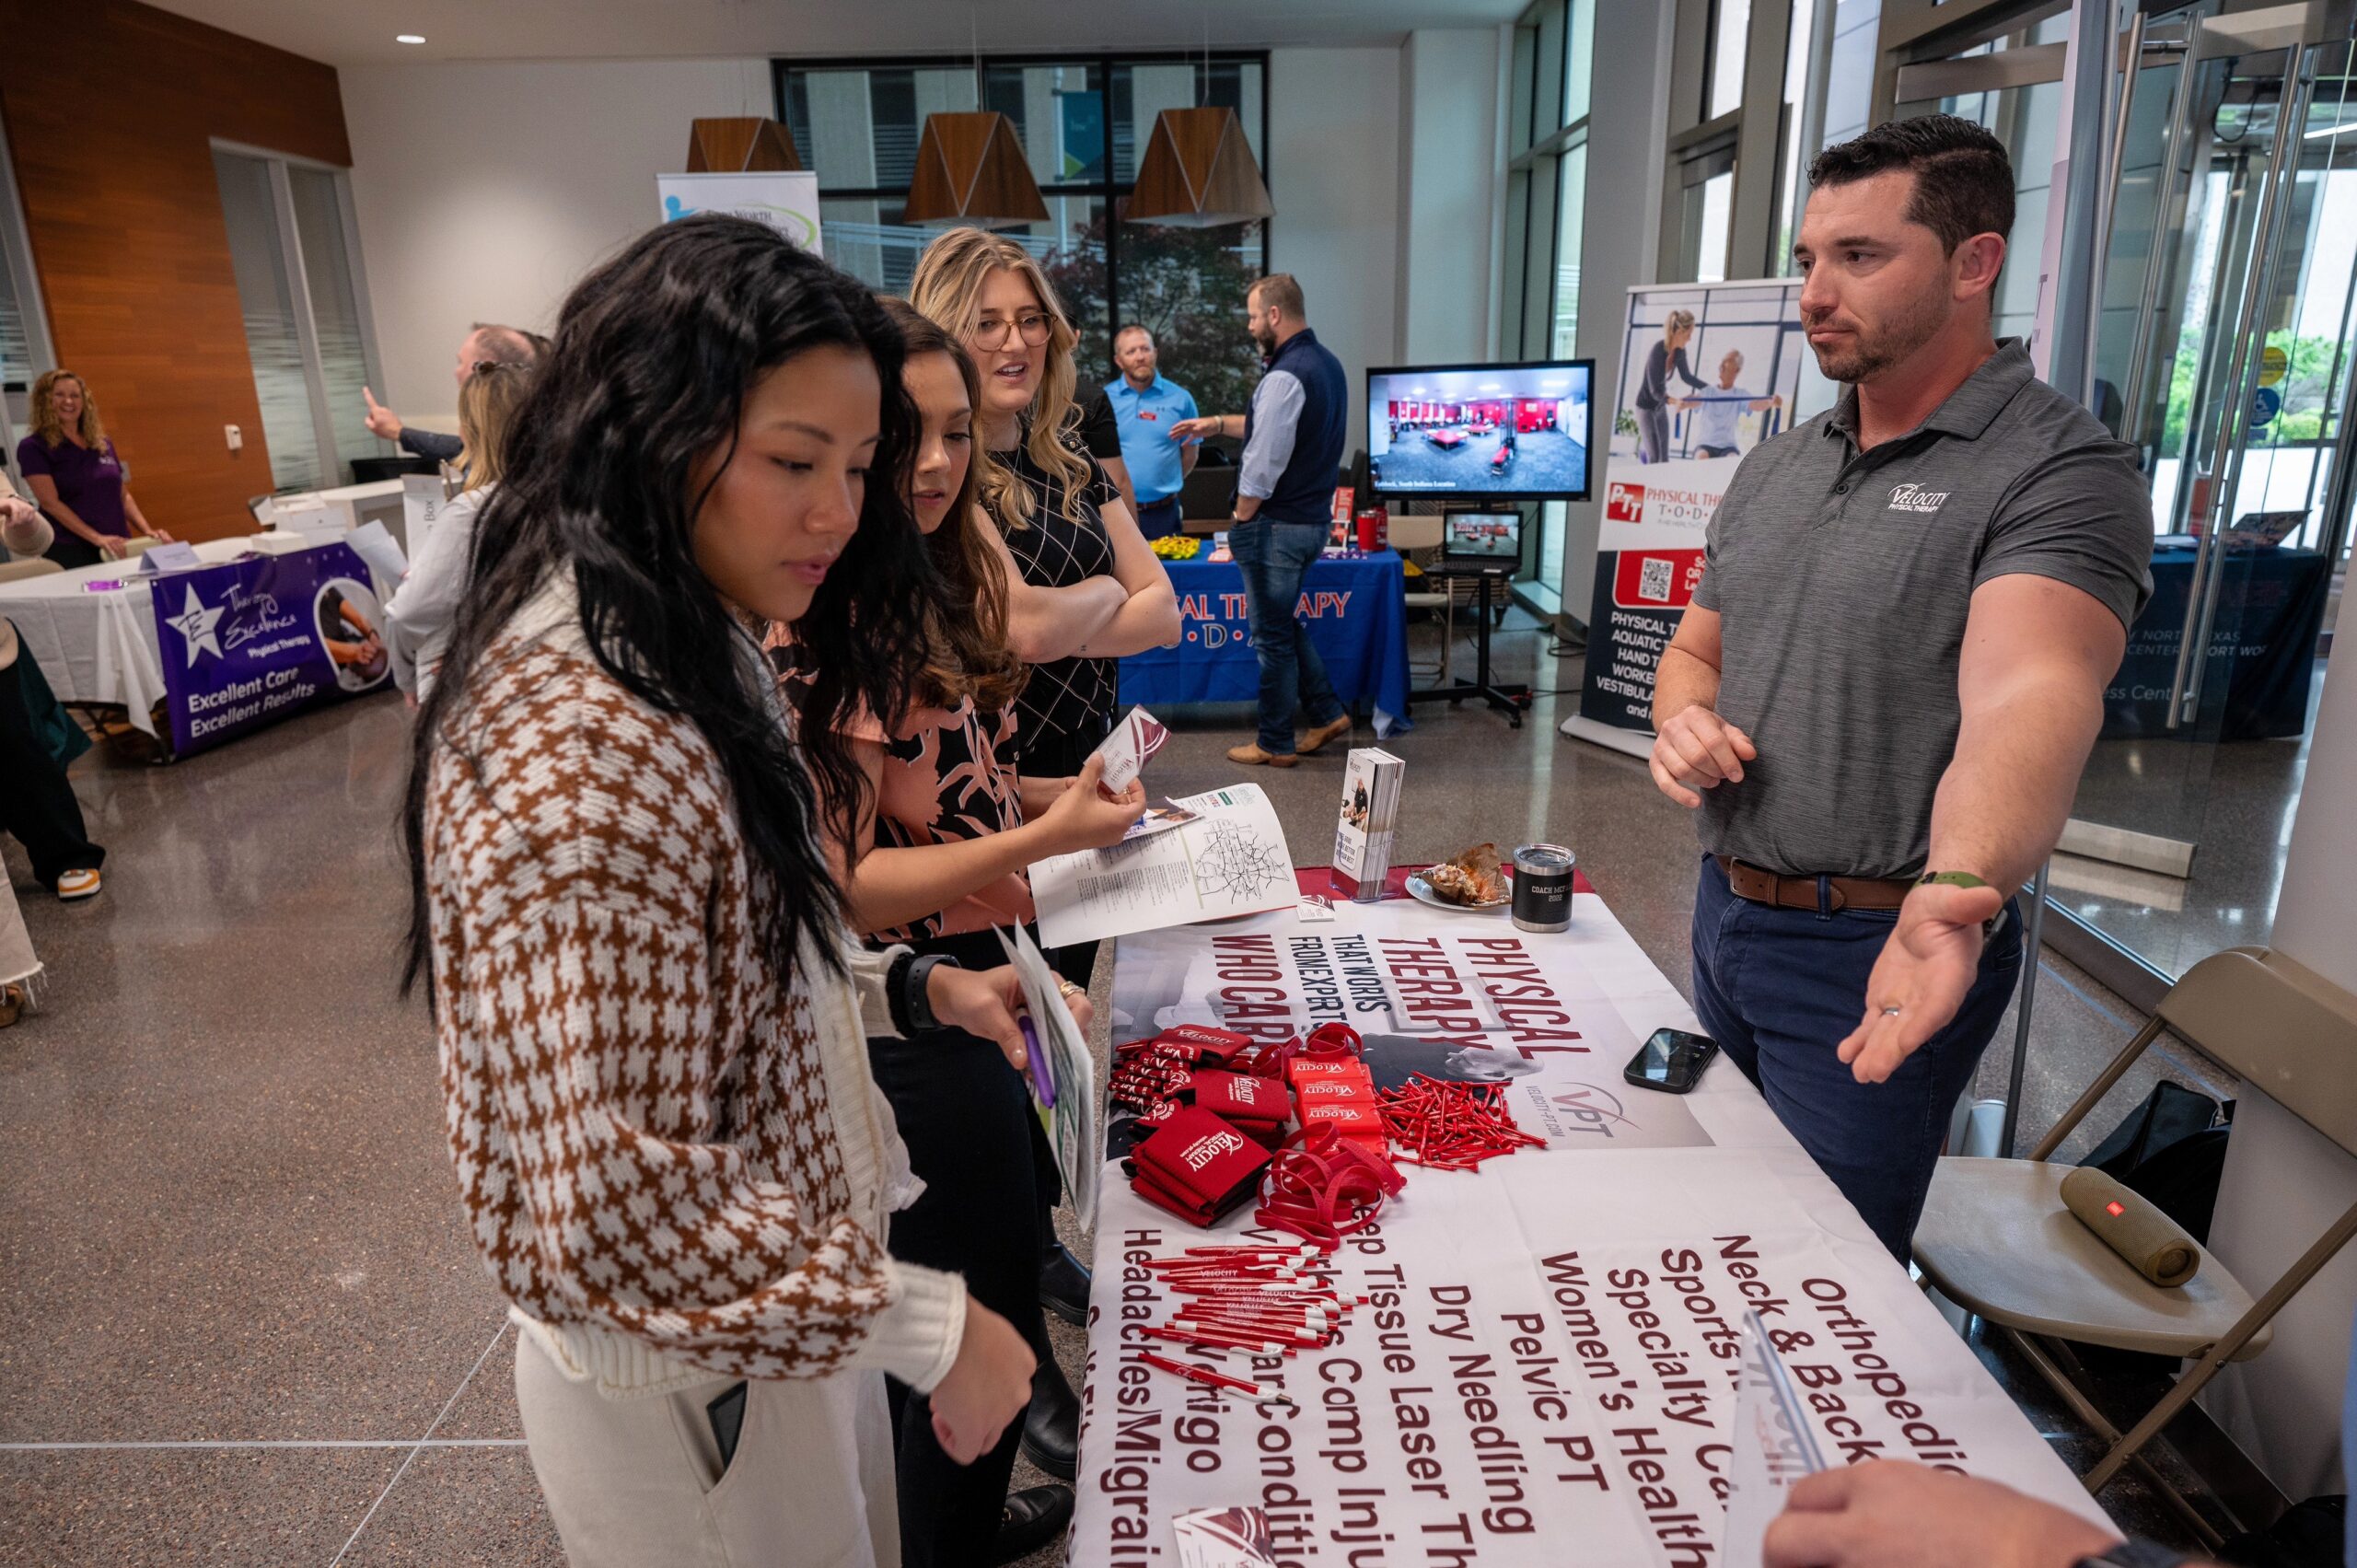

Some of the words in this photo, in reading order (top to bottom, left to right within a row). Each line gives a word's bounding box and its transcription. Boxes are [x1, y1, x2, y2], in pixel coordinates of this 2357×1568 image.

[1610, 484, 1641, 521] PTT
[1646, 488, 1699, 505] PHYSICAL
[1887, 503, 1913, 512] PHYSICAL
[1914, 505, 1940, 513] THERAPY
[1892, 487, 1951, 505] VELOCITY
[1610, 610, 1667, 635] PHYSICAL
[1611, 629, 1662, 651] AQUATIC
[2143, 629, 2182, 642] NORT
[1617, 647, 1651, 667] HAND
[188, 677, 263, 714] Excellent
[265, 667, 300, 690] Care
[190, 701, 261, 739] Excellent
[261, 682, 317, 713] Results
[1626, 703, 1648, 719] and
[1531, 885, 1553, 894] COACH
[1212, 934, 1283, 982] WHO
[1331, 934, 1374, 964] THAT
[1342, 966, 1393, 1013] WORKS
[1377, 937, 1495, 1051] THERAPY
[1457, 938, 1592, 1060] PHYSICAL
[1295, 1063, 1345, 1073] VELOCITY
[1238, 1076, 1259, 1105] VELOCITY
[1304, 1086, 1354, 1096] VELOCITY
[1525, 1086, 1566, 1137] VELOCITY-PT.COM
[1308, 1109, 1361, 1119] VELOCITY
[1189, 1132, 1241, 1172] VELOCITY
[1200, 1269, 1238, 1277] VELOCITY
[1712, 1235, 1791, 1318] Neck
[1363, 1261, 1417, 1375] Tissue
[1429, 1284, 1474, 1342] Dry
[1661, 1248, 1743, 1374] Sports
[1768, 1329, 1816, 1354] &
[1501, 1313, 1567, 1423] Pelvic
[1543, 1435, 1610, 1493] PT
[1541, 1250, 1635, 1412] Women's
[1612, 1426, 1716, 1568] Health
[1608, 1268, 1716, 1429] Specialty
[1695, 1443, 1734, 1513] Ca
[1318, 1358, 1369, 1474] Comp
[1789, 1365, 1887, 1466] Back
[1389, 1386, 1450, 1501] Laser
[1448, 1352, 1538, 1534] Needling
